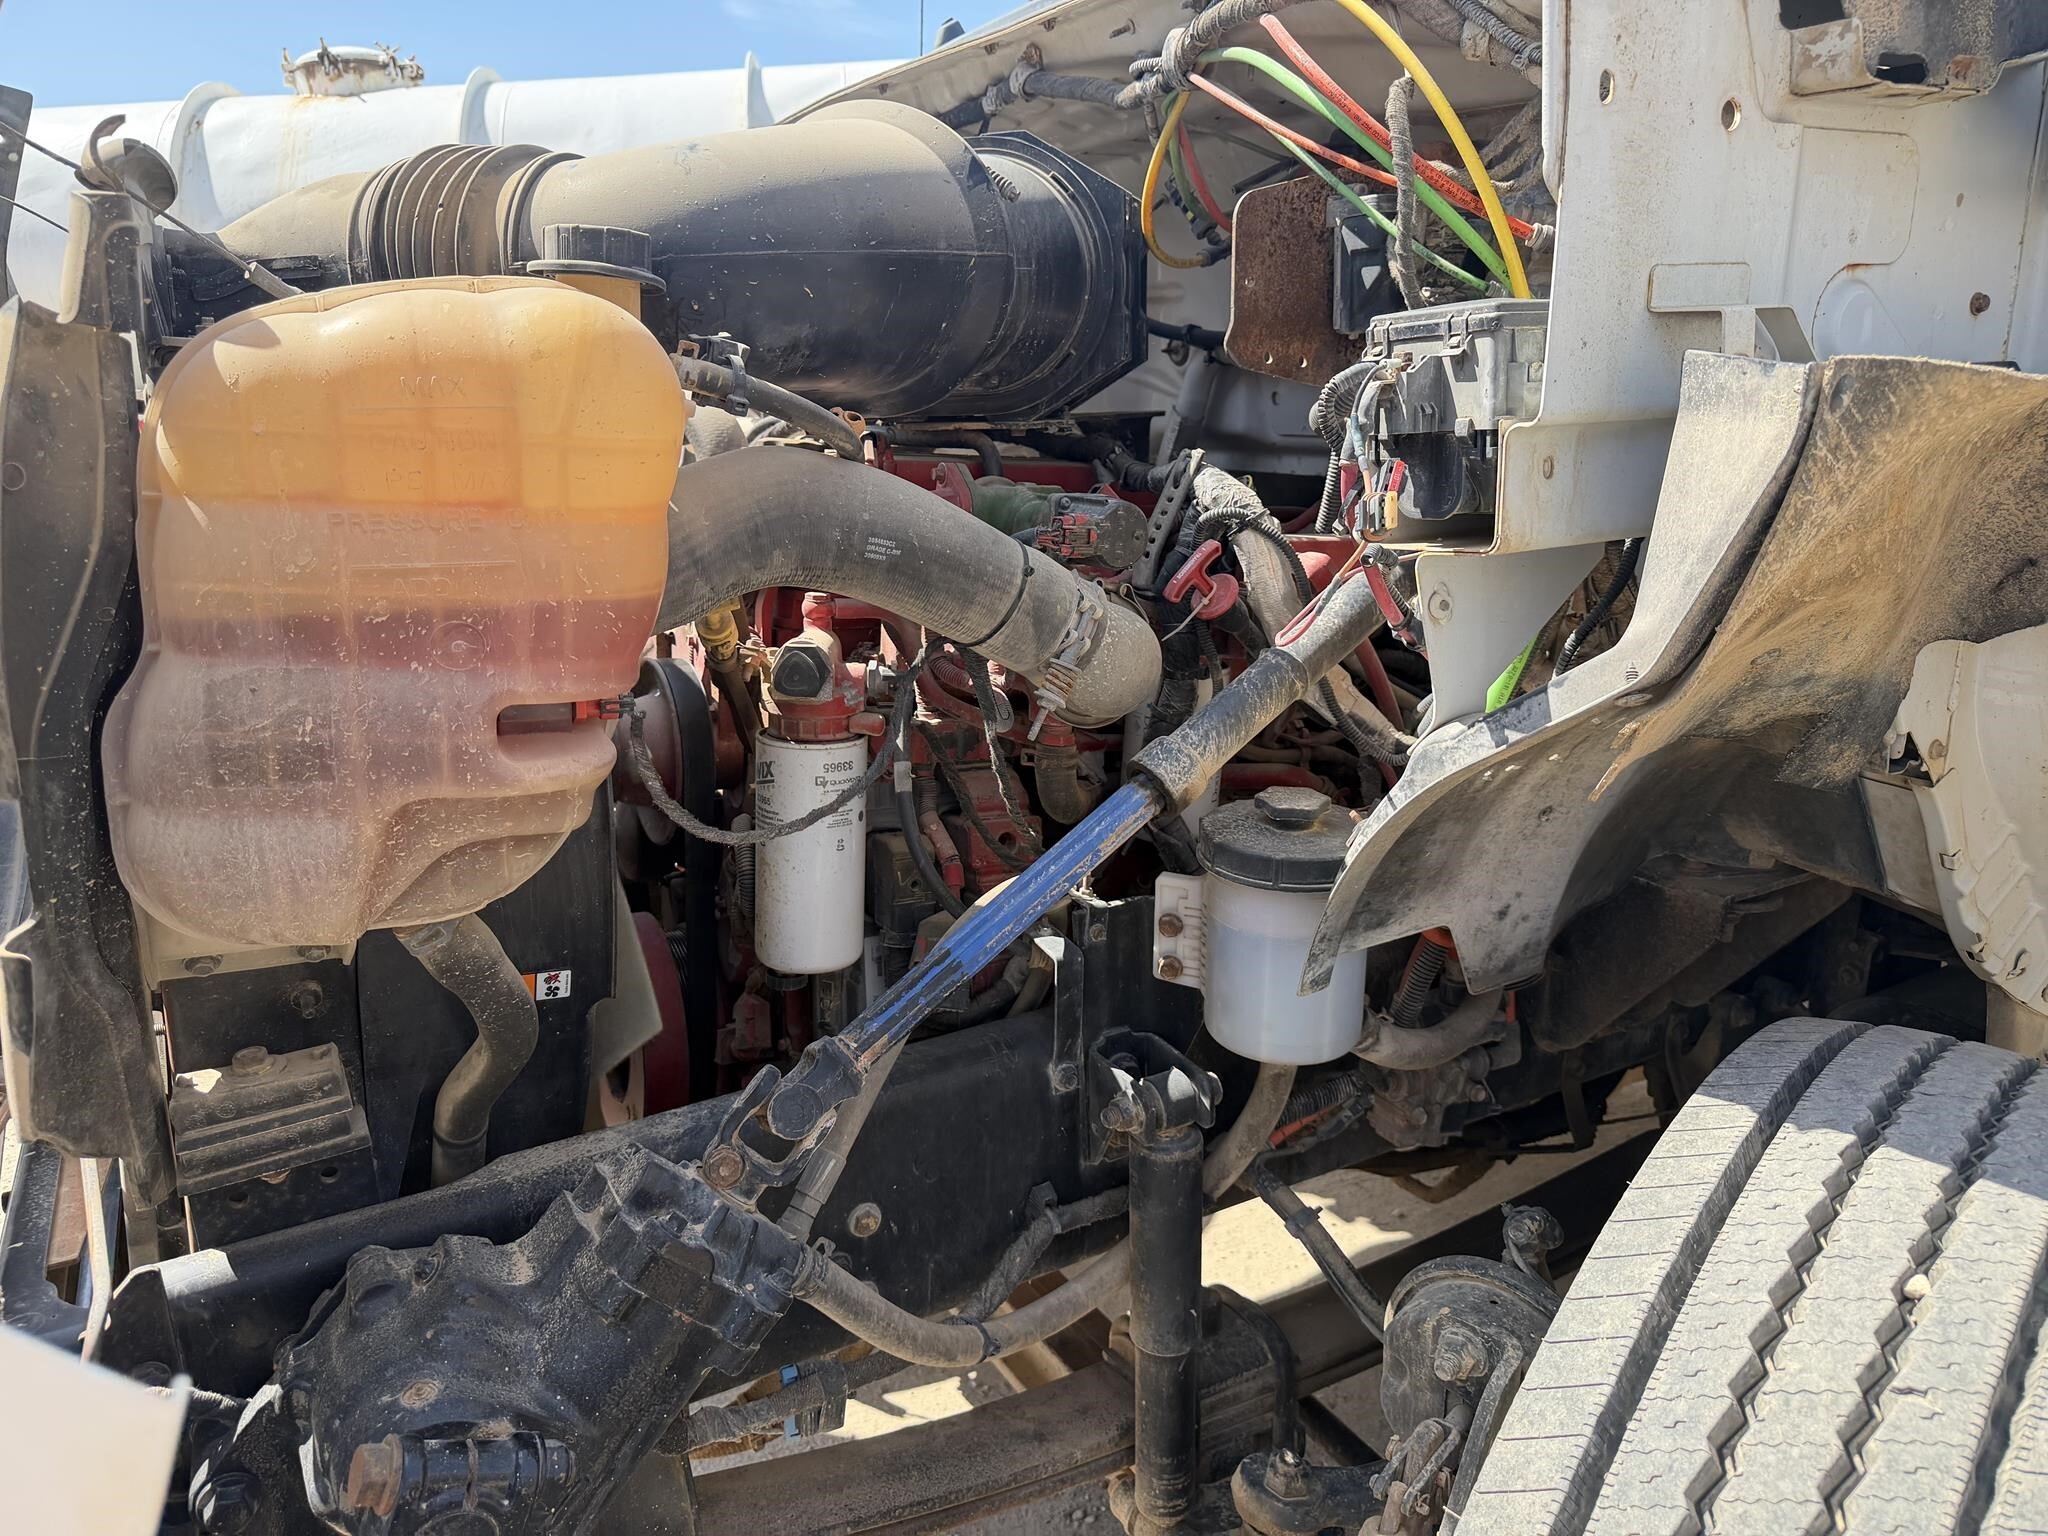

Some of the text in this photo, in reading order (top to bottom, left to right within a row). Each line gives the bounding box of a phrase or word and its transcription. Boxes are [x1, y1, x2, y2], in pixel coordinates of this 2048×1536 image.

[399, 375, 467, 399] MAX
[326, 509, 487, 535] PRESSURE
[822, 760, 854, 774] 33965
